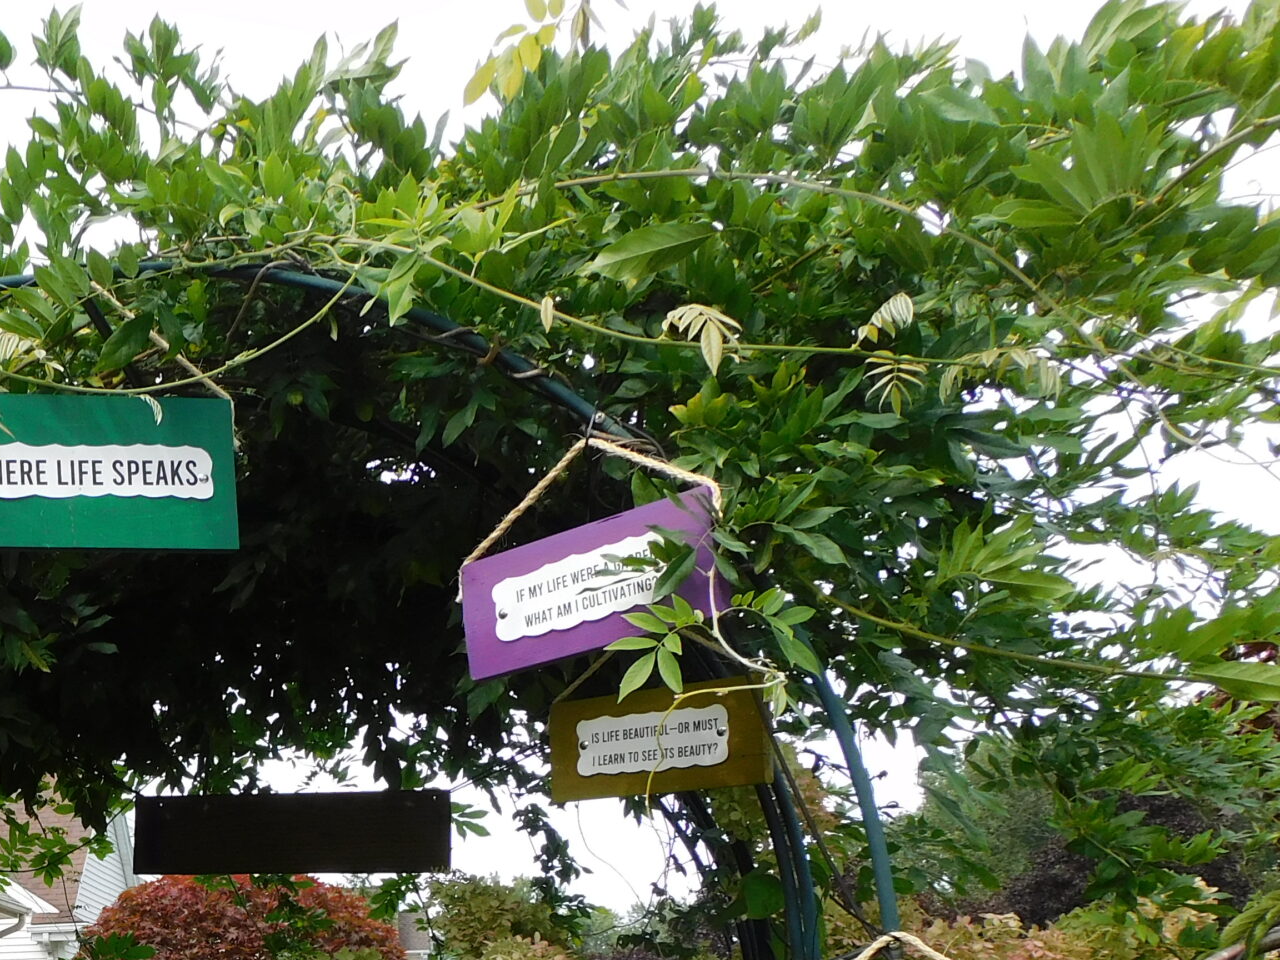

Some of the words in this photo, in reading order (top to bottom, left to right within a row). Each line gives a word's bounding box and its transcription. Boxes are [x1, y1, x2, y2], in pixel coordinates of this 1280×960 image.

[57, 459, 104, 486] LIFE
[112, 459, 198, 486] SPEAKS
[516, 588, 525, 603] IF
[528, 583, 544, 600] MY
[547, 574, 568, 594] LIFE
[570, 563, 600, 585] WERE
[524, 611, 553, 629] WHAT
[556, 602, 573, 619] AM
[575, 599, 579, 613] I
[591, 732, 600, 744] IS
[602, 729, 620, 743] LIFE
[693, 717, 719, 733] MUST
[592, 755, 596, 767] I
[598, 752, 626, 767] LEARN
[628, 750, 639, 763] TO
[641, 749, 658, 762] SEE
[661, 747, 675, 760] TS
[677, 742, 719, 758] BEAUTY?
